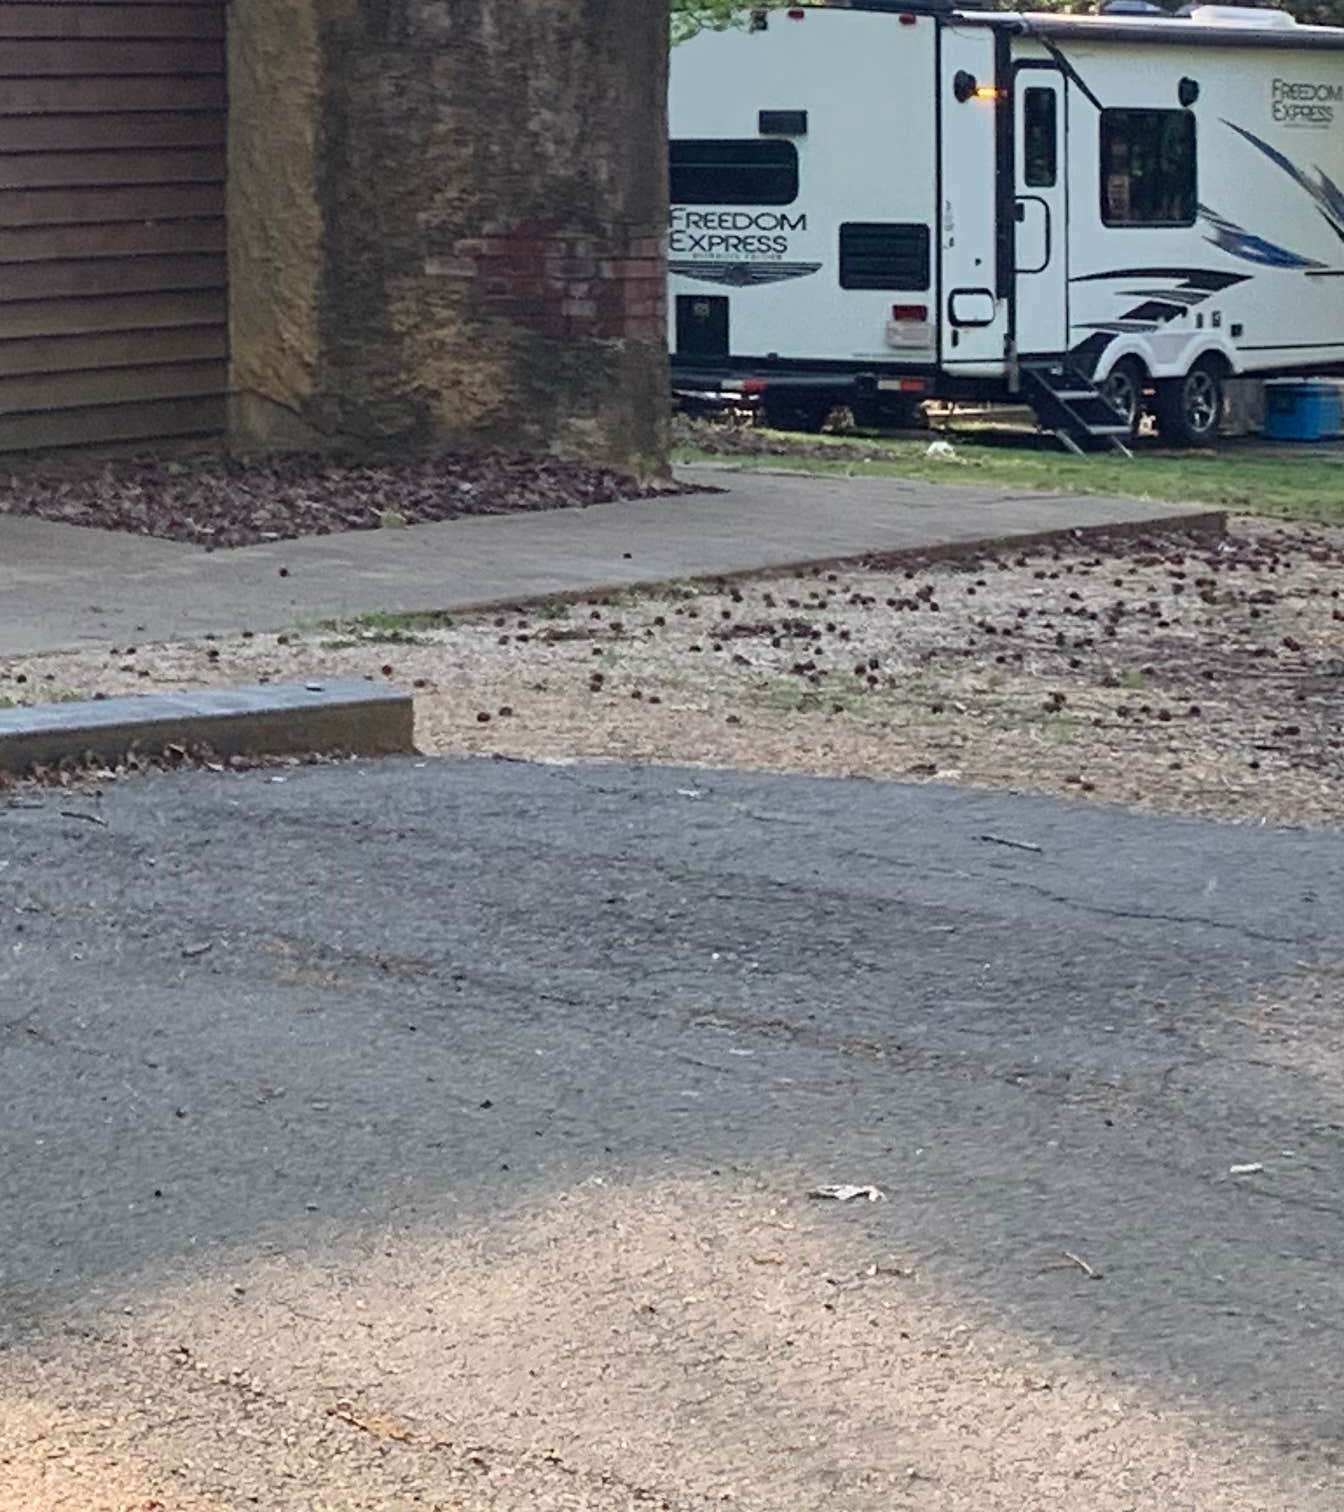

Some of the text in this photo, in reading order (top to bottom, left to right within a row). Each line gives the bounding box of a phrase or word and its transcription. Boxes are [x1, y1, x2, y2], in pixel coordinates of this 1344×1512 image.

[1273, 78, 1344, 101] FREEDOM
[1273, 100, 1334, 123] EXPRESS
[669, 207, 807, 231] FREEDOM
[670, 230, 788, 254] EXPRESS
